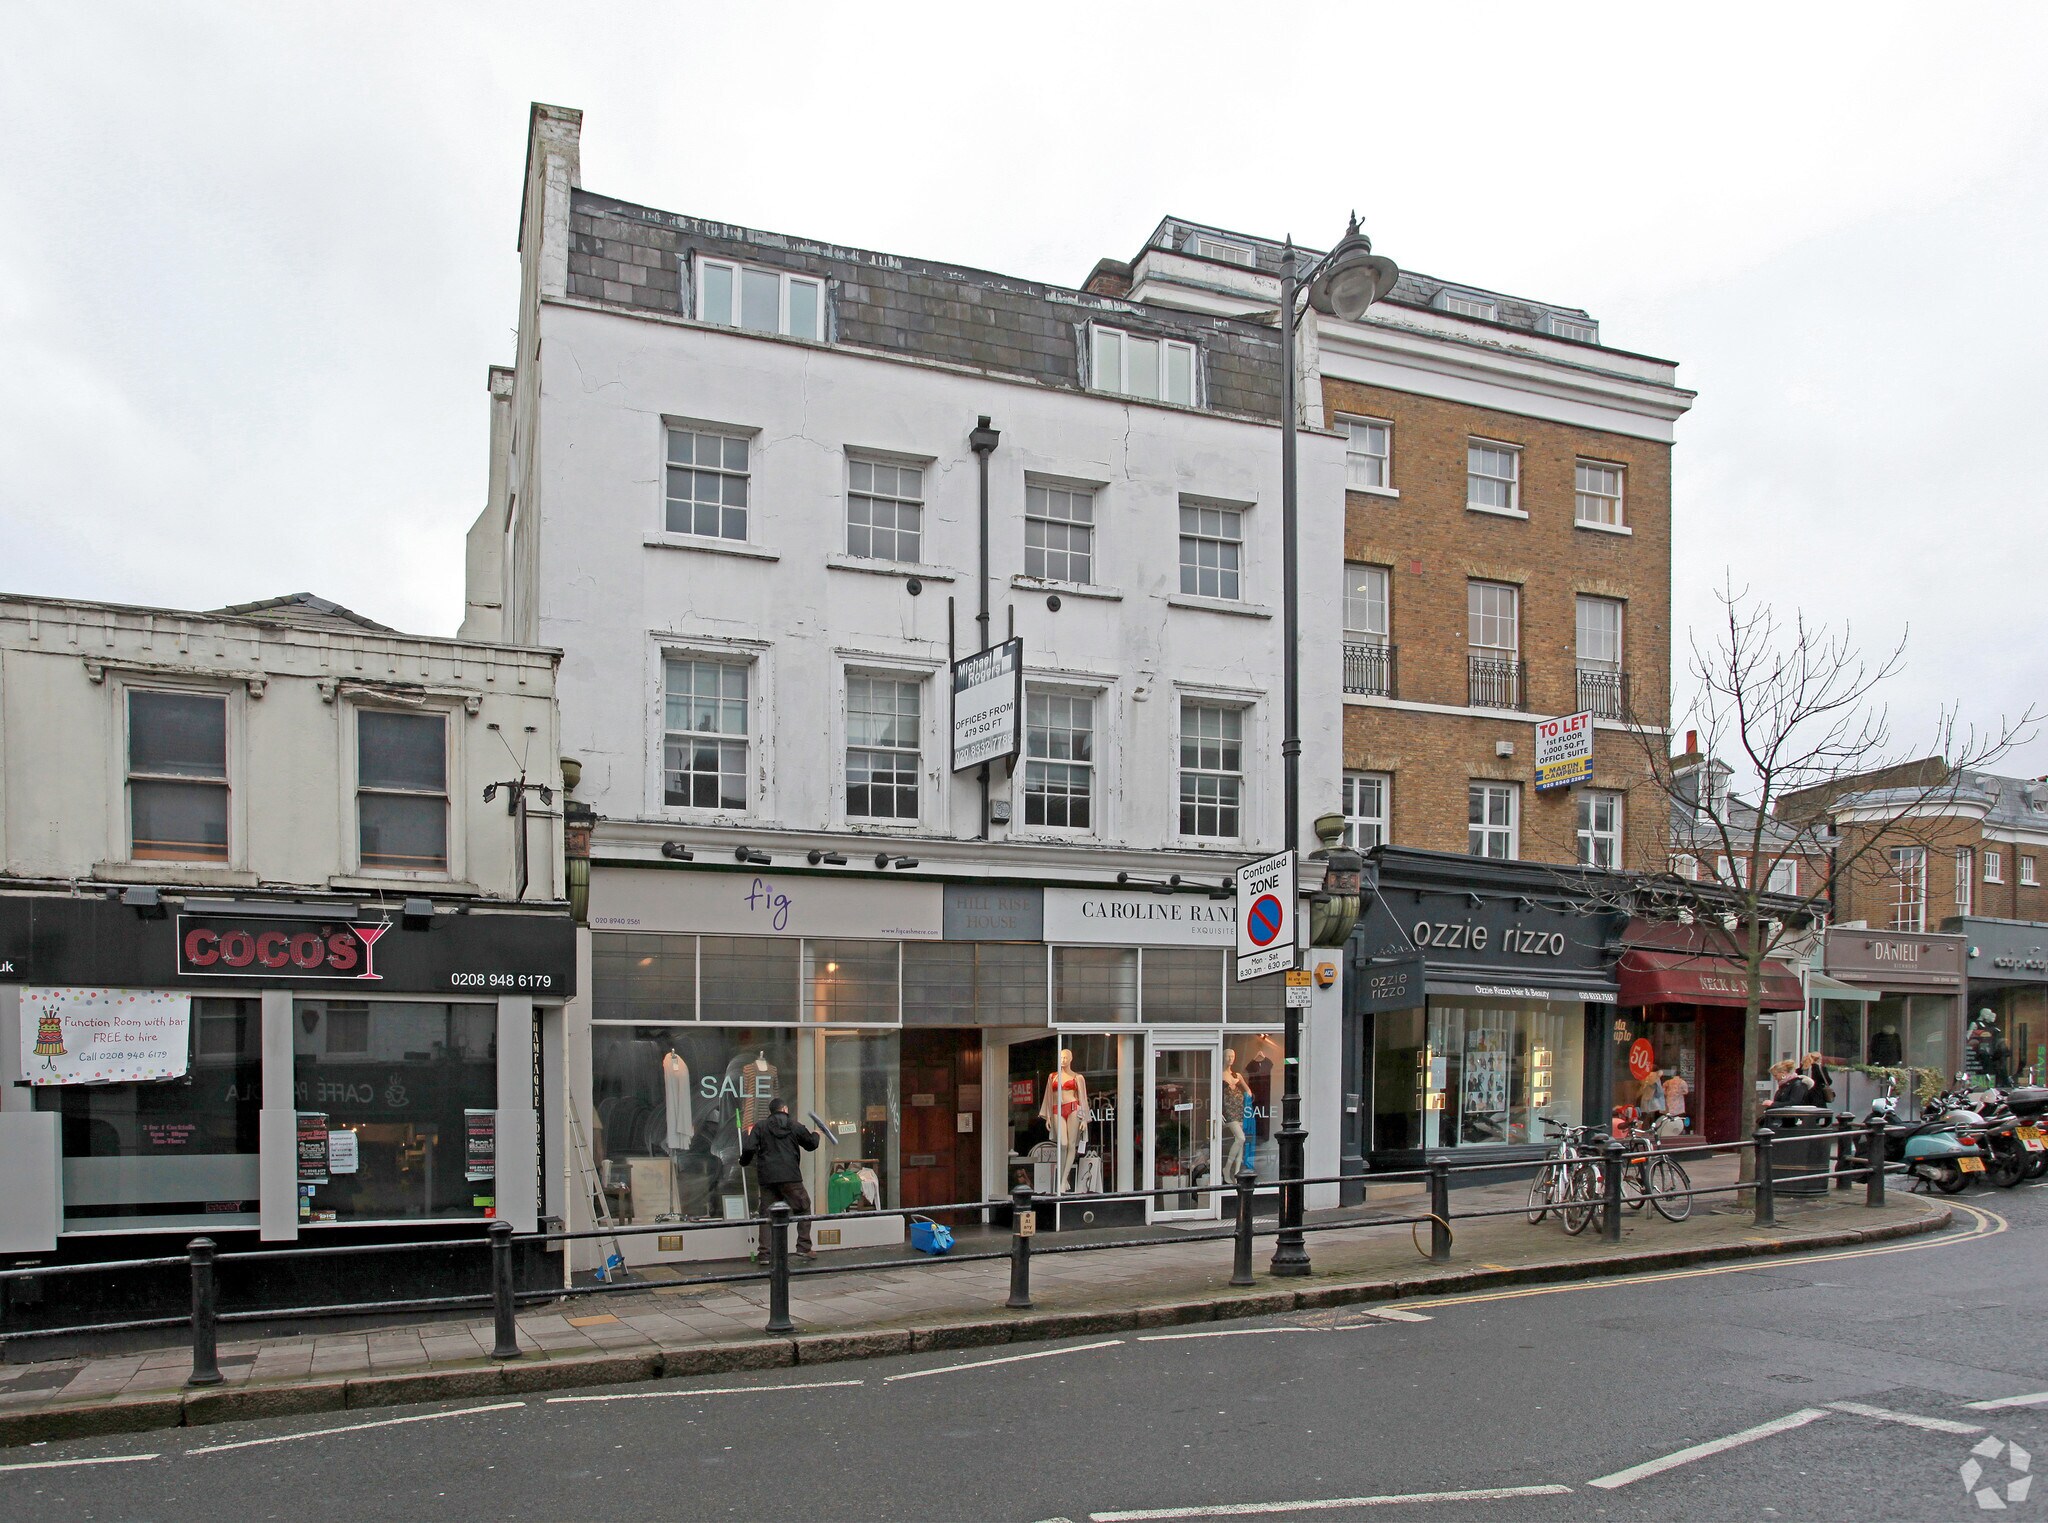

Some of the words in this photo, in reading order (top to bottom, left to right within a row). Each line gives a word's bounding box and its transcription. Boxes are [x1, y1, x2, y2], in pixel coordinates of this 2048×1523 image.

[957, 651, 992, 676] Michael
[968, 664, 1001, 688] Rogers
[956, 711, 987, 730] OFFICES
[989, 702, 1013, 717] FROM
[964, 727, 977, 738] 479
[979, 722, 990, 733] SQ
[992, 717, 1002, 729] FT
[1540, 722, 1558, 738] TO
[1563, 714, 1588, 733] LET
[1546, 738, 1556, 746] 1st
[1559, 732, 1582, 742] FLOOR
[1543, 745, 1562, 755] 1,000
[1564, 739, 1585, 750] SQ.FT
[956, 748, 969, 761] 020
[1539, 753, 1565, 764] OFFICE
[1567, 747, 1588, 757] SUITE
[1544, 766, 1583, 780] CAMPBELL
[1549, 762, 1578, 773] MARTIN
[1242, 856, 1287, 880] Controlled
[1250, 874, 1279, 896] ZONE
[744, 878, 792, 931] fig
[955, 896, 991, 910] HILL
[998, 897, 1032, 911] RISE
[1082, 901, 1182, 921] CAROLINE
[595, 917, 607, 925] 020
[609, 917, 625, 925] 8940
[627, 918, 641, 926] 2561
[966, 915, 1017, 929] HOUSE
[881, 927, 939, 936] www.figcashmere.com
[1191, 926, 1235, 935] EXQUISITE
[1413, 918, 1488, 950] ozzie
[1503, 922, 1565, 956] rizzo
[185, 926, 358, 969] COCO'S
[1875, 942, 1918, 962] DANIELI
[1252, 957, 1263, 966] Mon
[1269, 953, 1278, 961] Sat
[1282, 960, 1291, 969] pm
[451, 973, 485, 986] 0208
[489, 974, 514, 987] 948
[518, 974, 551, 987] 6179
[1371, 972, 1407, 988] ozzie
[1700, 977, 1729, 992] NECK
[1731, 980, 1739, 992] &
[1740, 980, 1769, 994] NK
[1372, 985, 1406, 999] rizzo
[1475, 985, 1493, 994] Ozzie
[1494, 986, 1511, 995] Rizzo
[1511, 987, 1524, 996] Hair
[1525, 988, 1530, 996] &
[1531, 989, 1550, 999] Beauty
[65, 1016, 110, 1027] Function
[114, 1017, 141, 1027] Room
[145, 1017, 166, 1027] with
[169, 1018, 185, 1026] bar
[93, 1033, 121, 1043] FREE
[125, 1033, 135, 1042] to
[138, 1033, 157, 1042] hire
[79, 1052, 97, 1061] Call
[100, 1051, 124, 1060] 0208
[127, 1051, 144, 1060] 948
[148, 1050, 167, 1059] 6179
[701, 1076, 772, 1099] SALE
[1012, 1083, 1031, 1095] SALE
[1244, 1106, 1278, 1119] SALE
[2027, 1140, 2038, 1148] L
